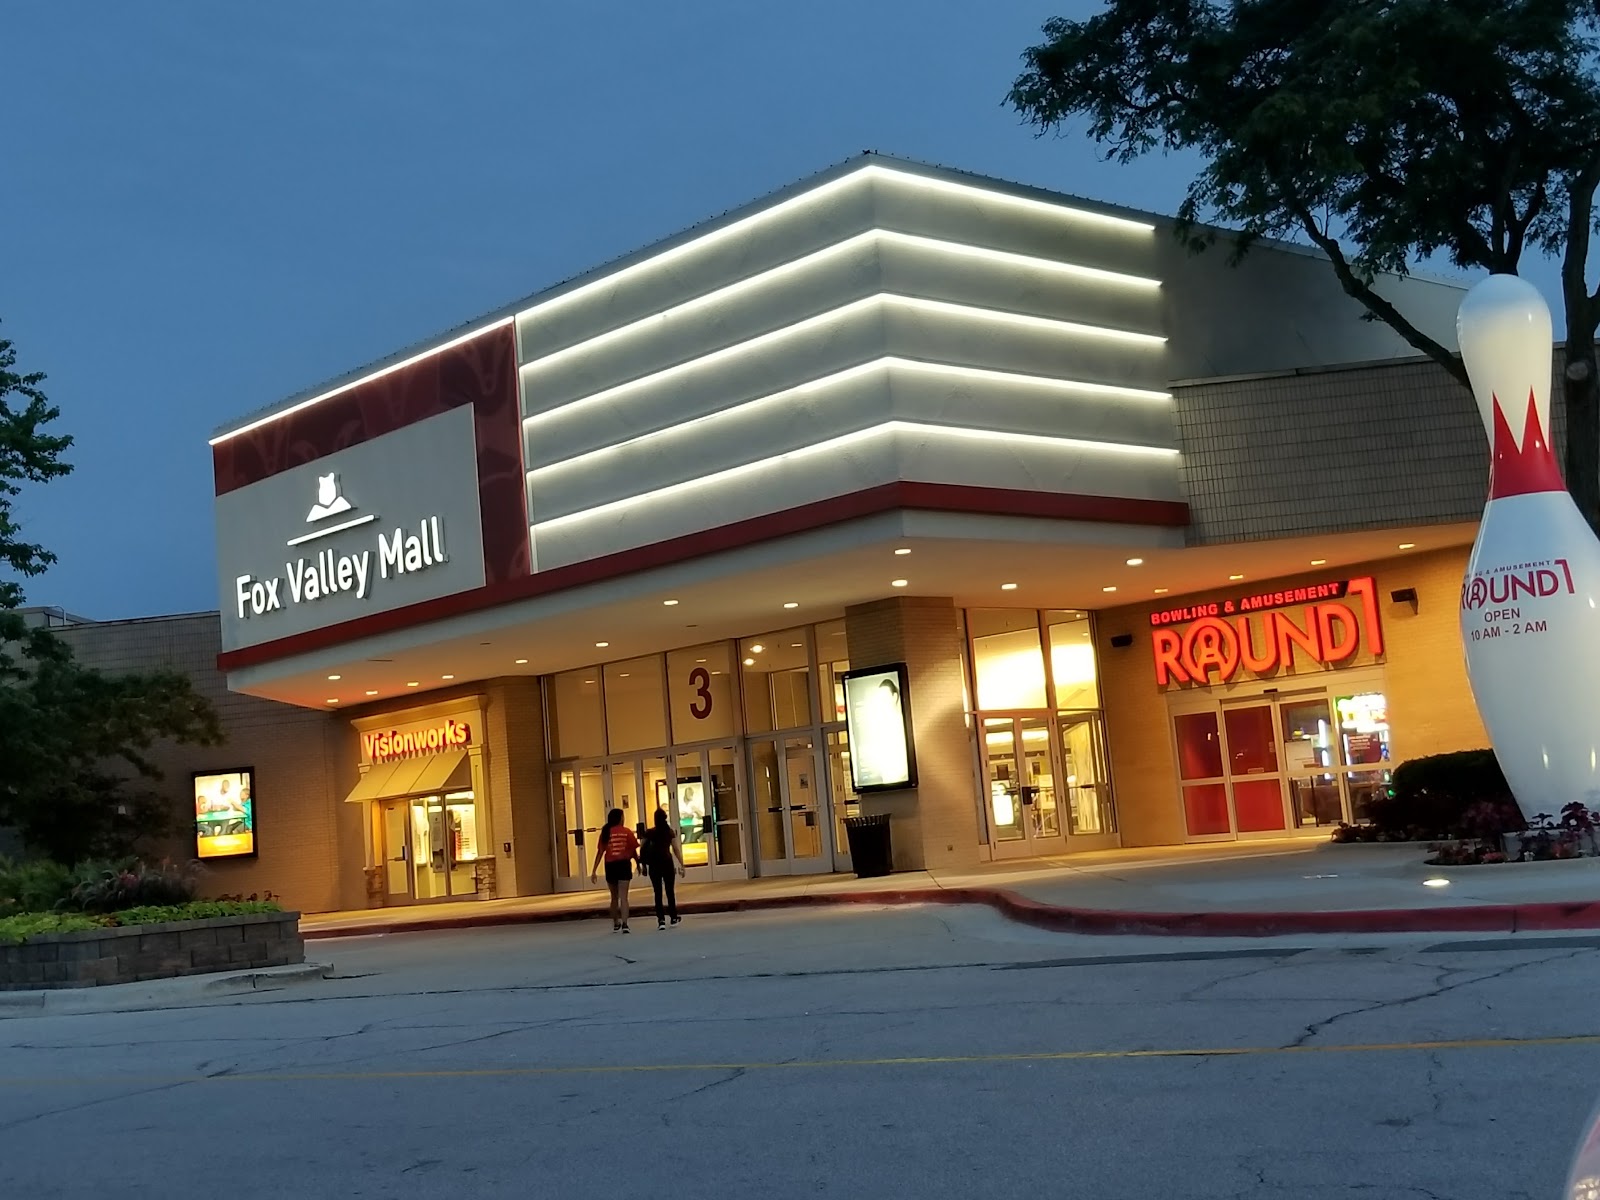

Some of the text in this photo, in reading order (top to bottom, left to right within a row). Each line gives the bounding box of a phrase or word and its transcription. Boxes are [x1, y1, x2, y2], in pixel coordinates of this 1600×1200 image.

[235, 515, 444, 619] Fox Valley Mall
[1151, 582, 1340, 625] BOWLING & AMUSEMENT
[1484, 607, 1520, 623] OPEN
[1471, 629, 1481, 642] 10
[1483, 626, 1501, 640] AM
[1512, 623, 1521, 635] 2
[1525, 620, 1547, 633] AM
[688, 667, 713, 720] 3
[363, 719, 469, 759] Visionworks
